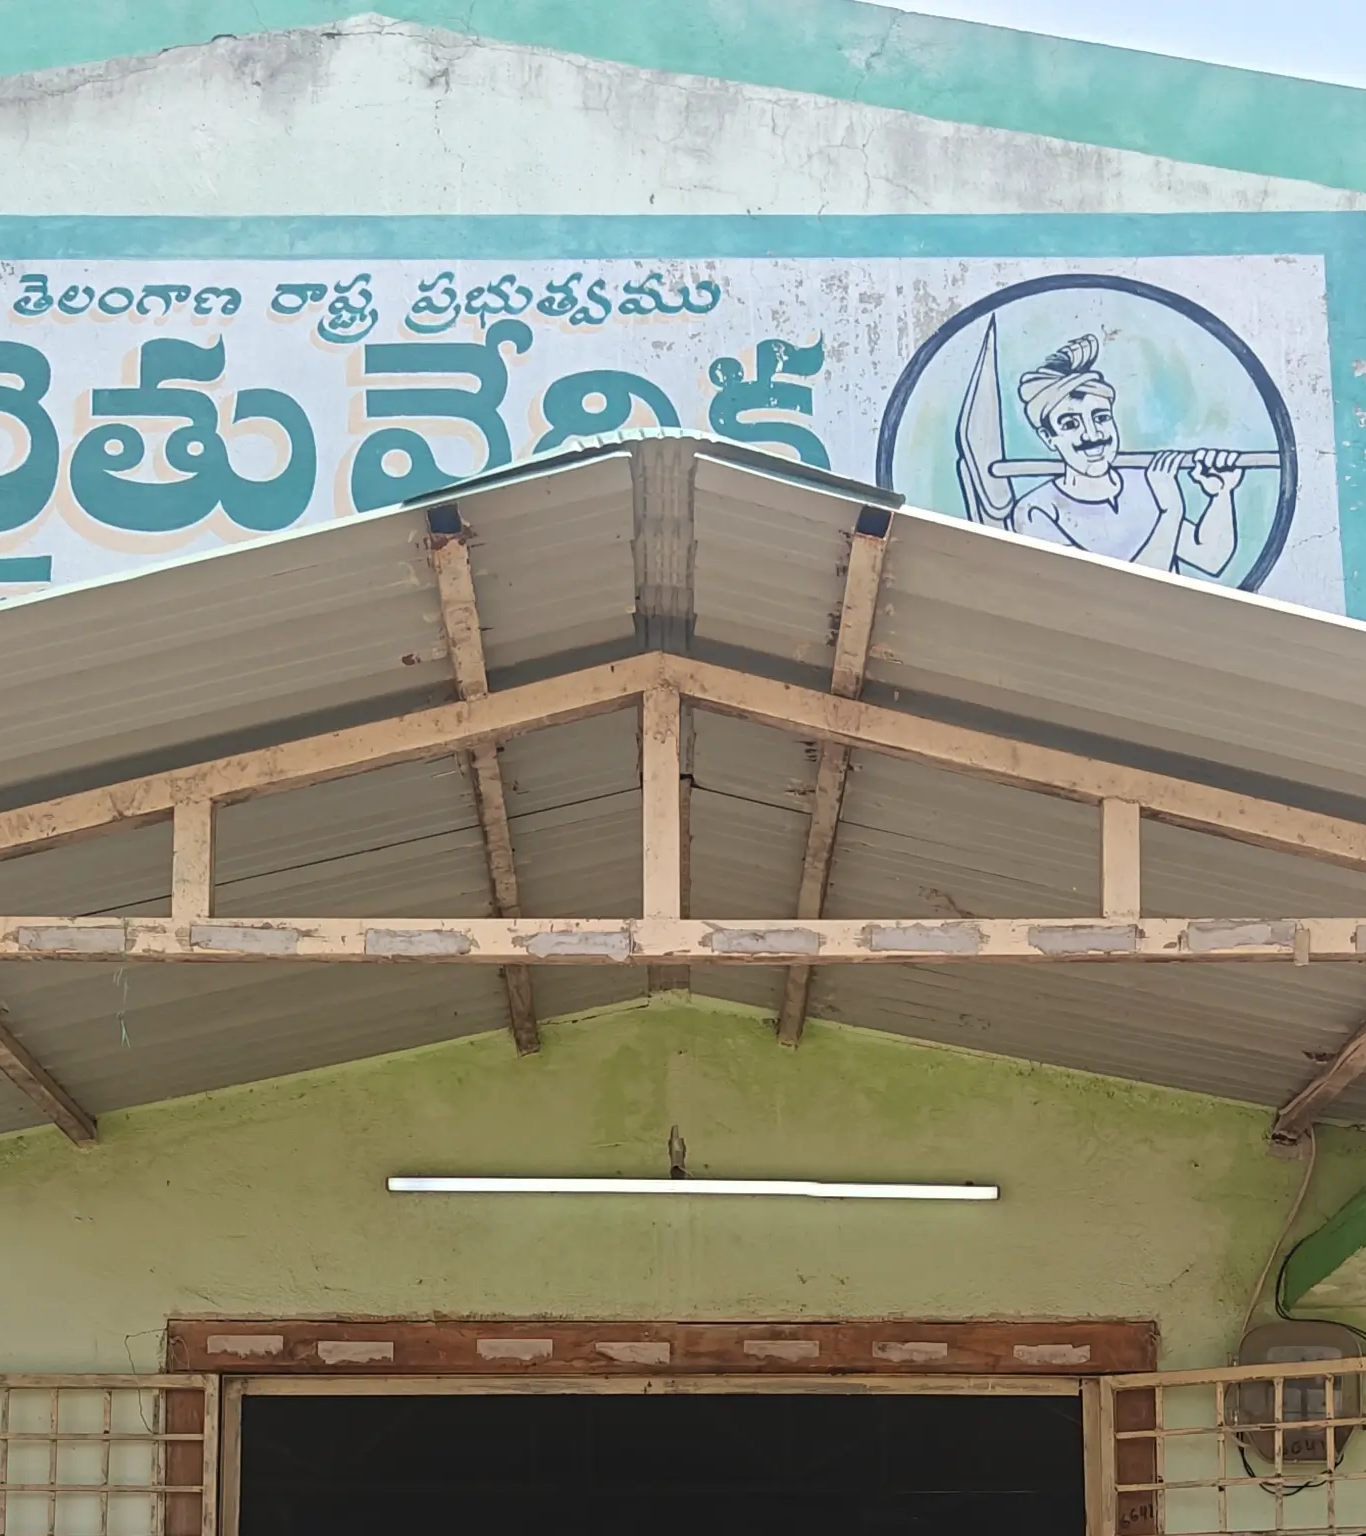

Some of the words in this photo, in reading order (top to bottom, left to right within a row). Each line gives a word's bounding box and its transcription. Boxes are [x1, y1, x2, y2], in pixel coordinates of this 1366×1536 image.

[13, 273, 242, 317] తెలంగాణ
[270, 272, 379, 344] రాష్ట్ర
[404, 271, 721, 335] ప్రభుత్వము
